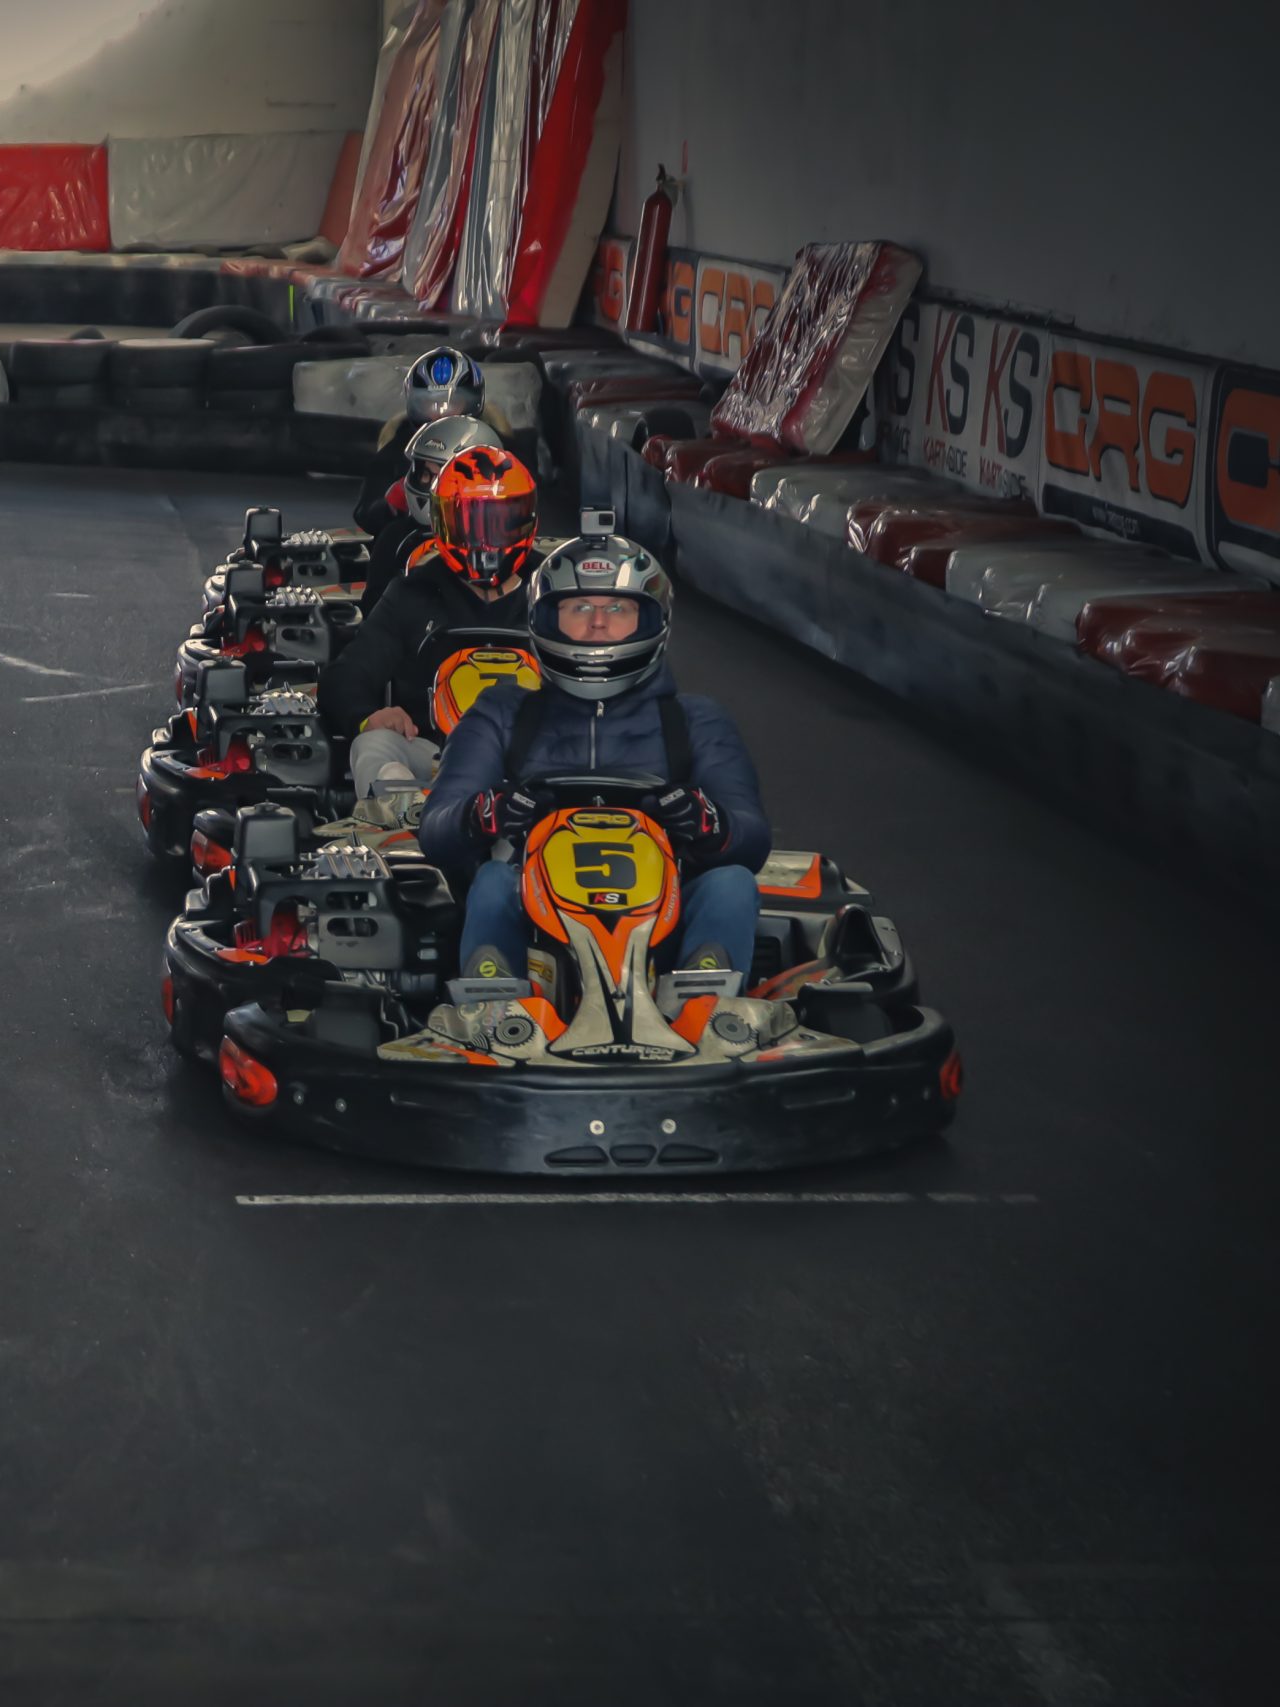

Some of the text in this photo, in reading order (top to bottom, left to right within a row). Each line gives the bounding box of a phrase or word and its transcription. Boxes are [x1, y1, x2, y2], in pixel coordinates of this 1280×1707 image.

[925, 308, 976, 436] KS
[979, 322, 1041, 459] KS
[1044, 349, 1197, 510] CRG
[582, 561, 614, 571] BELL
[571, 841, 637, 890] 5
